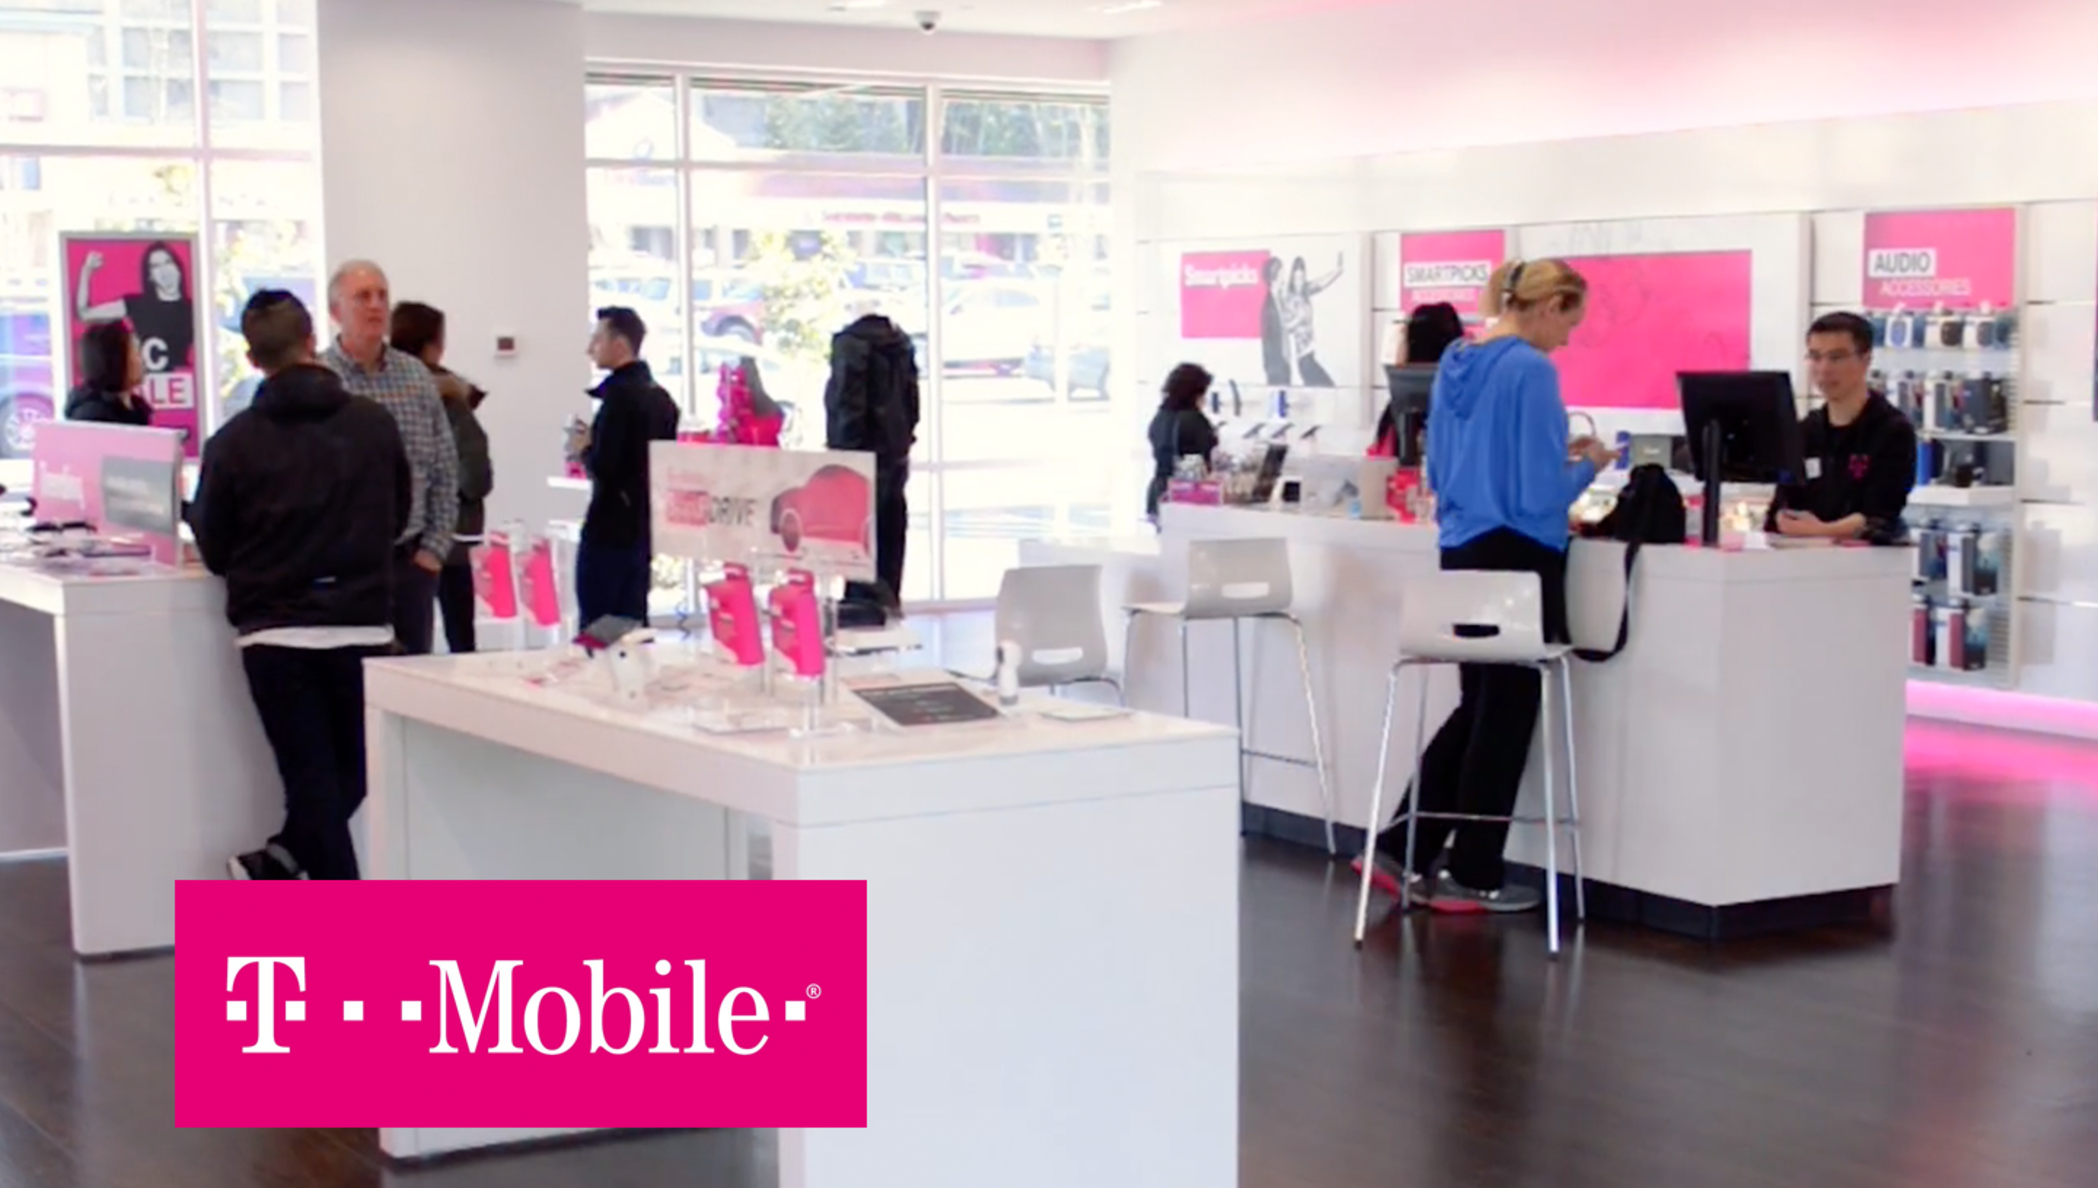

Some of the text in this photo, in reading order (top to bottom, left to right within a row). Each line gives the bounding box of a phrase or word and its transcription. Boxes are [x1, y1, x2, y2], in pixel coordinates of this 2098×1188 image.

[1406, 263, 1488, 283] SMARTPICKS
[1874, 251, 1931, 273] AUDIO
[1184, 262, 1259, 290] Smartpicks
